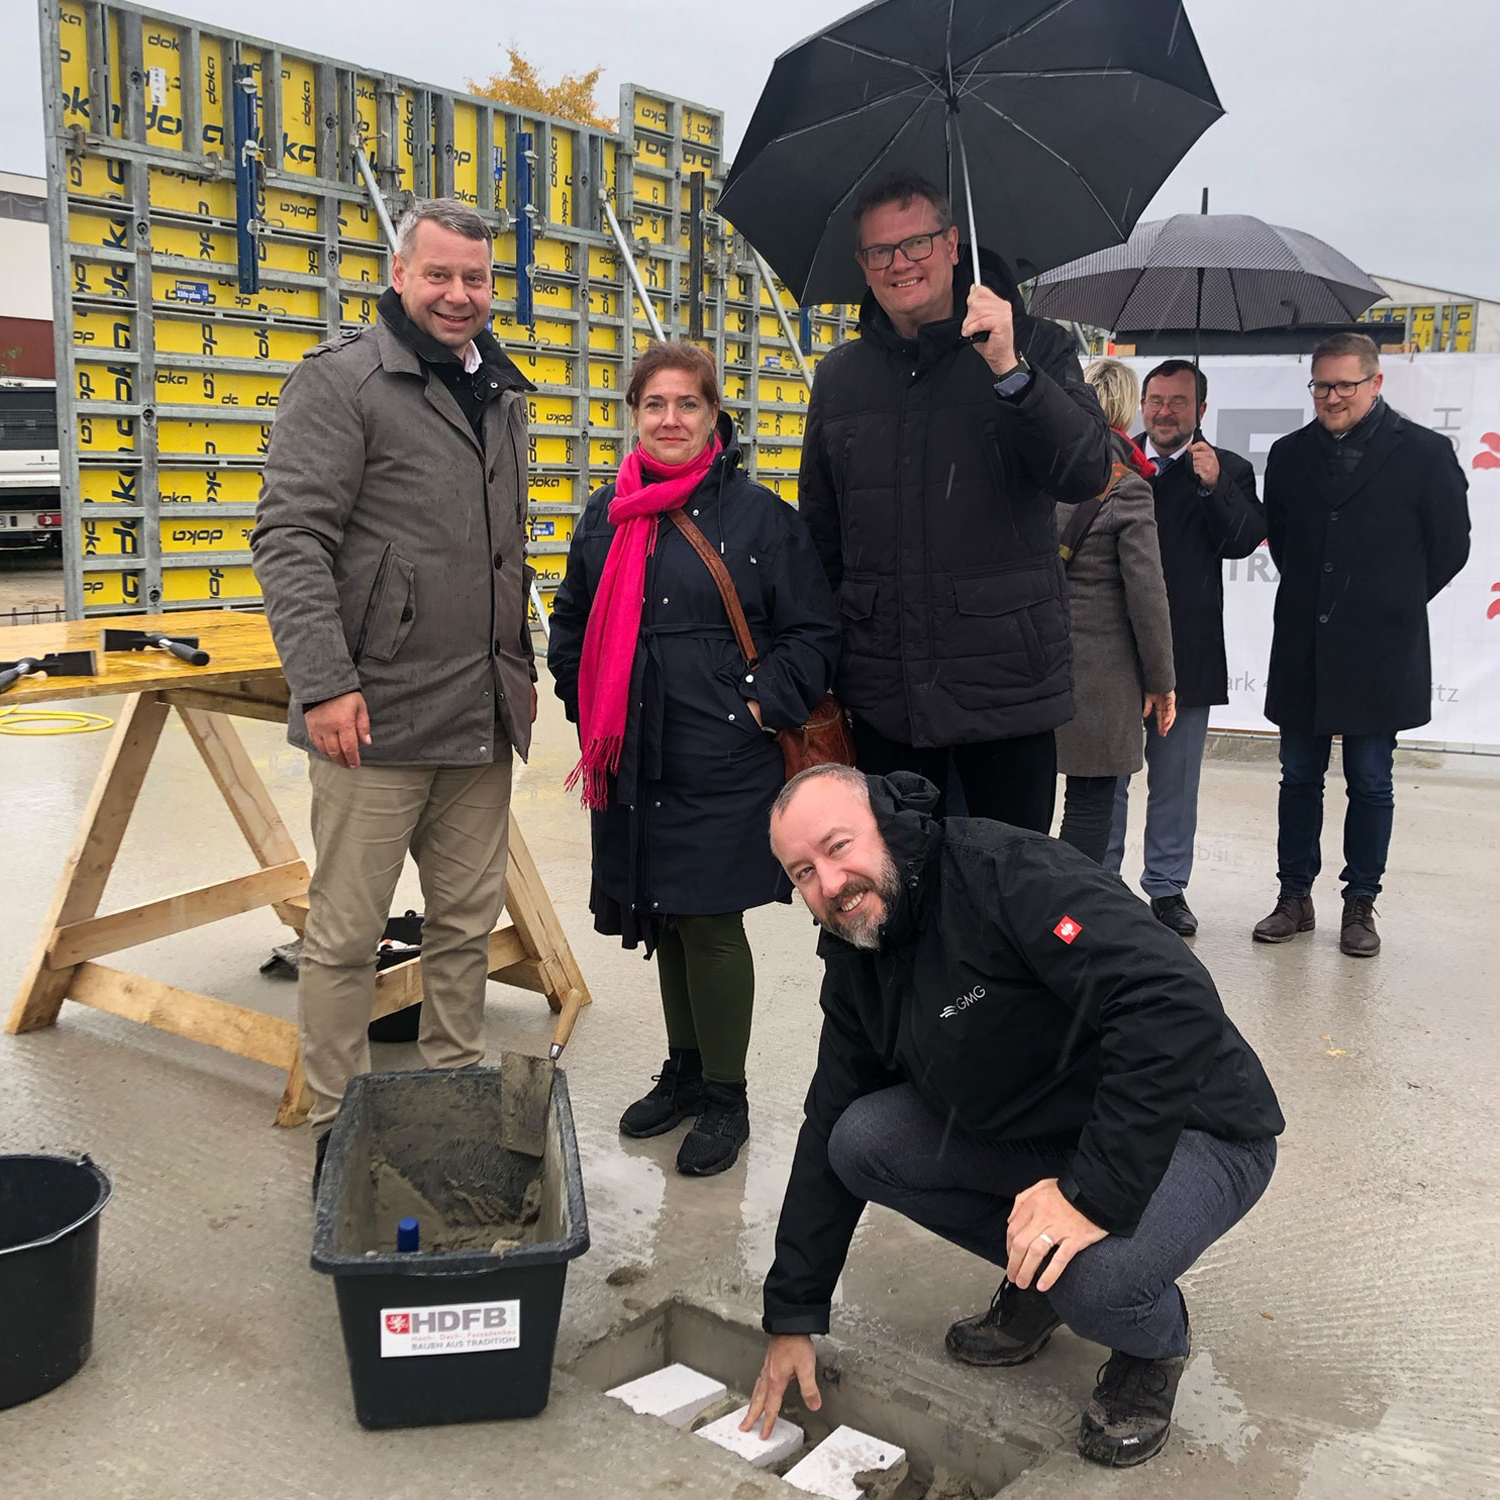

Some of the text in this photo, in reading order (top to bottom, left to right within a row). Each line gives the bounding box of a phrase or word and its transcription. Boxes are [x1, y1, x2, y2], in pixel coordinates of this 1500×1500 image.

[59, 7, 82, 26] ka
[148, 33, 180, 52] dok
[204, 57, 216, 104] doka
[301, 81, 311, 126] doka
[283, 133, 316, 164] ka
[454, 190, 478, 204] oka
[280, 203, 317, 219] doka
[599, 254, 617, 265] dok
[533, 283, 559, 296] oka
[156, 371, 188, 385] oka
[256, 391, 280, 407] do
[546, 413, 572, 424] doka
[600, 441, 617, 452] dok
[159, 492, 191, 503] oka
[173, 529, 223, 545] doka
[533, 568, 560, 580] oka
[955, 985, 986, 1010] GMG
[411, 1307, 508, 1335] HDFB
[411, 1335, 517, 1351] BAUEN AUS TRADITION
